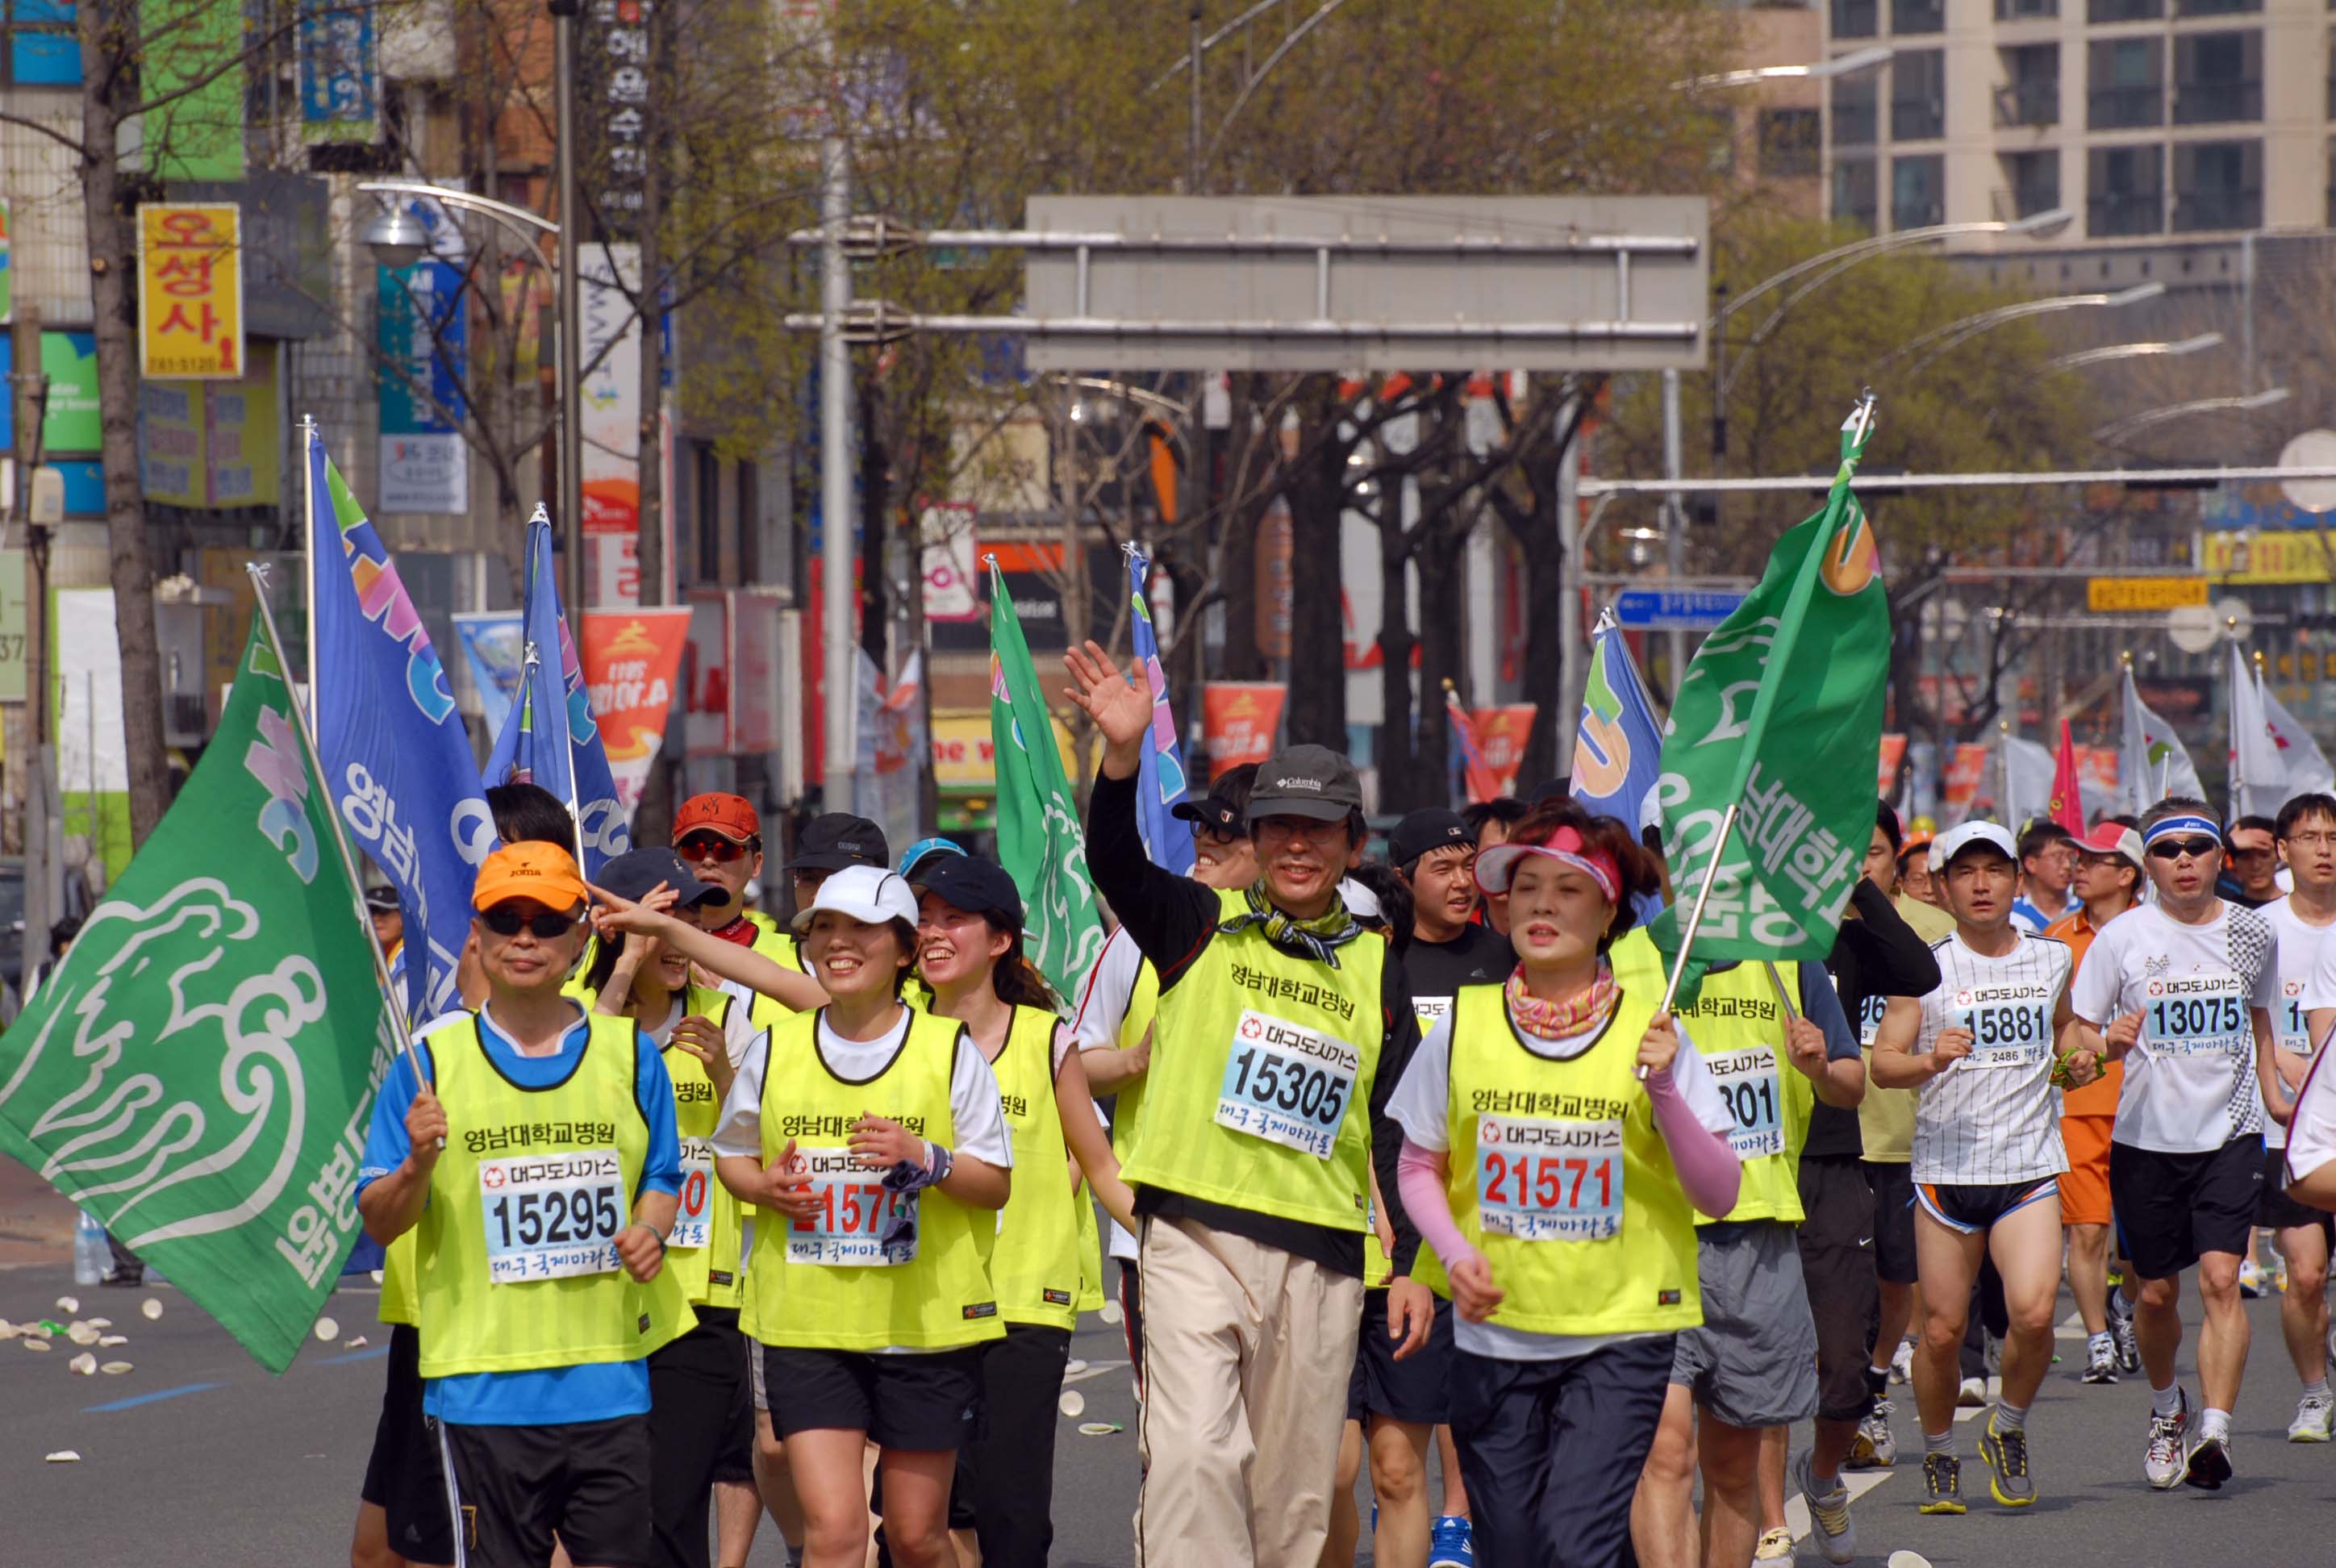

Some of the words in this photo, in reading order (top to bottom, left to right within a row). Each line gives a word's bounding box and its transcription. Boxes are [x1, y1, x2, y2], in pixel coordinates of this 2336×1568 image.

[156, 212, 221, 344] 오성사
[1287, 777, 1321, 787] Columbia
[1231, 963, 1354, 1021] 영남대학교병원
[1975, 987, 2048, 1002] 대구도시가스
[2167, 979, 2239, 994] 대구도시가스
[1964, 1005, 2044, 1045] 15881
[2154, 997, 2240, 1036] 13075
[1266, 1026, 1357, 1071] 대구도시가스
[1992, 1051, 2019, 1062] 2486
[2152, 1041, 2175, 1054] 대구
[1234, 1049, 1348, 1124] 15305
[1219, 1103, 1249, 1126] 대구
[1472, 1089, 1629, 1122] 영남대학교병원
[464, 1123, 615, 1153] 영남대학교병원
[1506, 1126, 1621, 1148] 대구도시가스
[511, 1158, 618, 1183] 대구도시가스
[1484, 1151, 1612, 1209] 21571
[493, 1186, 618, 1248] 15295
[1483, 1215, 1514, 1234] 대구
[792, 1242, 822, 1260] 대구
[492, 1257, 527, 1276] 대구
